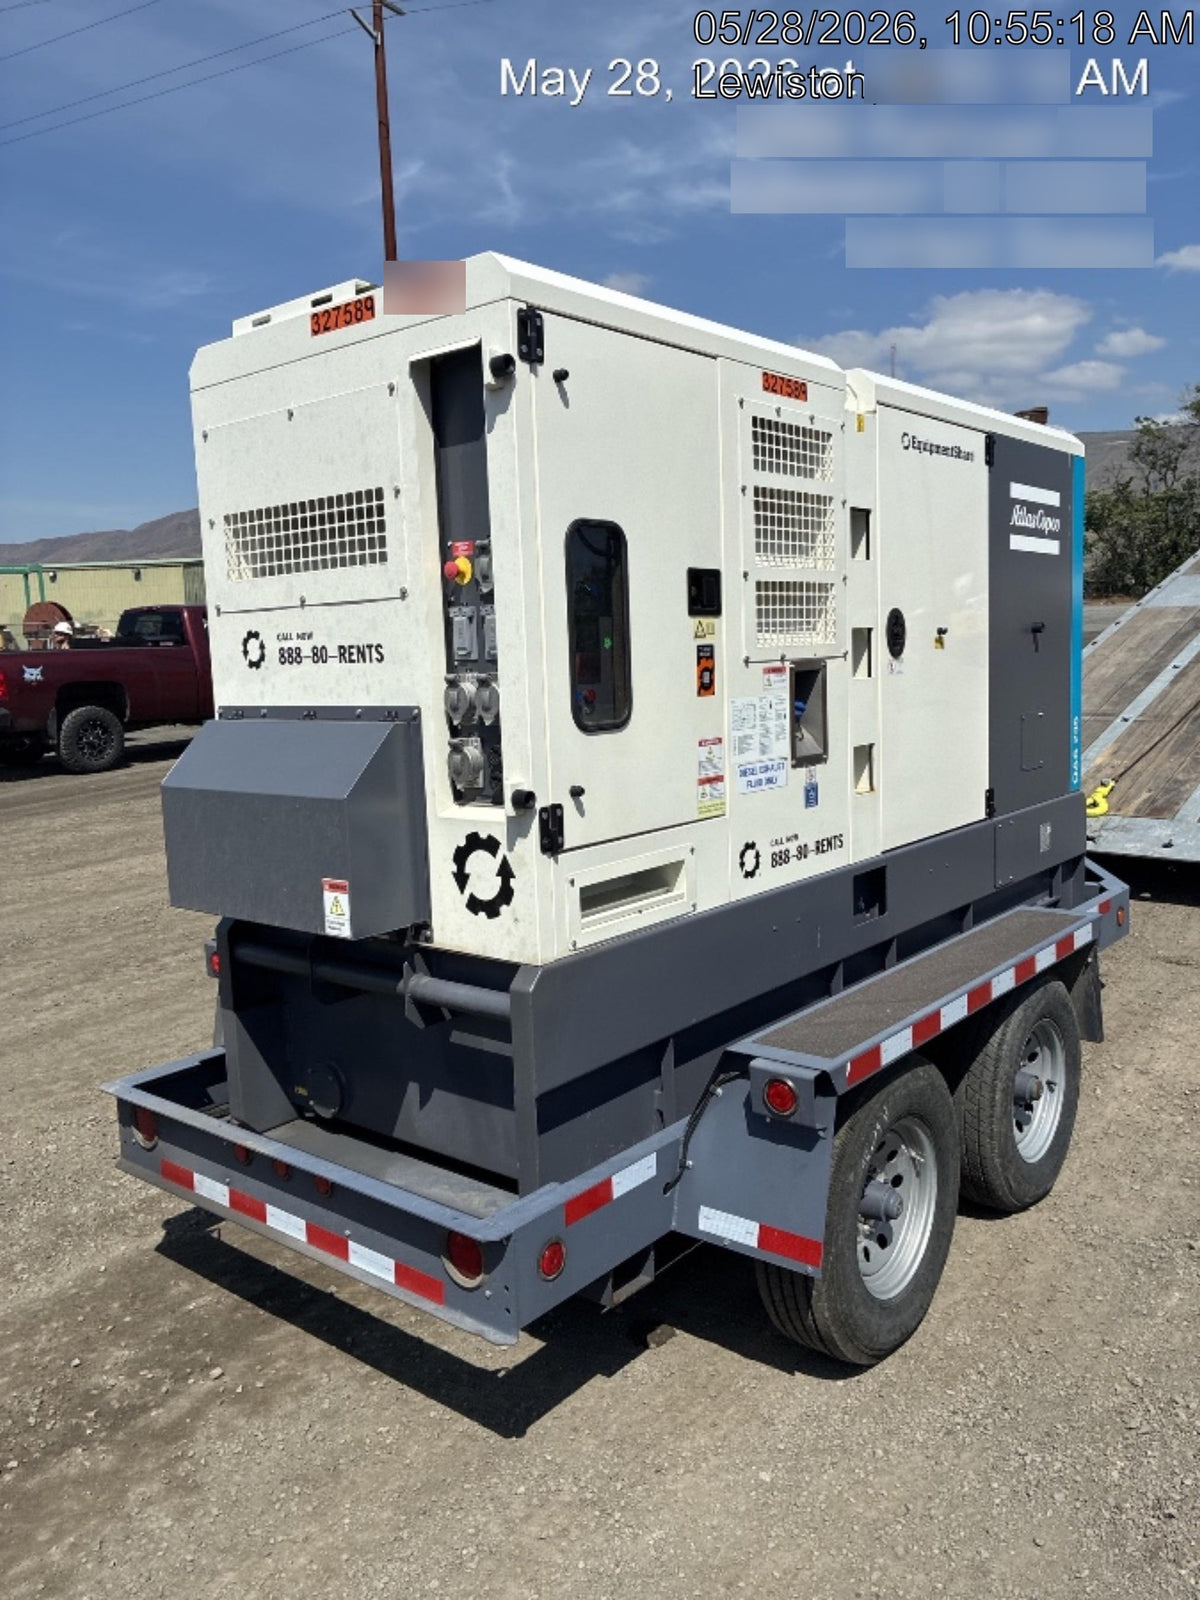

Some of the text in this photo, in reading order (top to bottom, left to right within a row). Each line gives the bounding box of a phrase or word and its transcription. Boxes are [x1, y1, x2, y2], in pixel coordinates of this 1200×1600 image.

[311, 295, 375, 336] 327589
[763, 371, 808, 401] 327589
[278, 643, 385, 665] 888-80-RENTS
[771, 833, 843, 868] 888-80-RENTS
